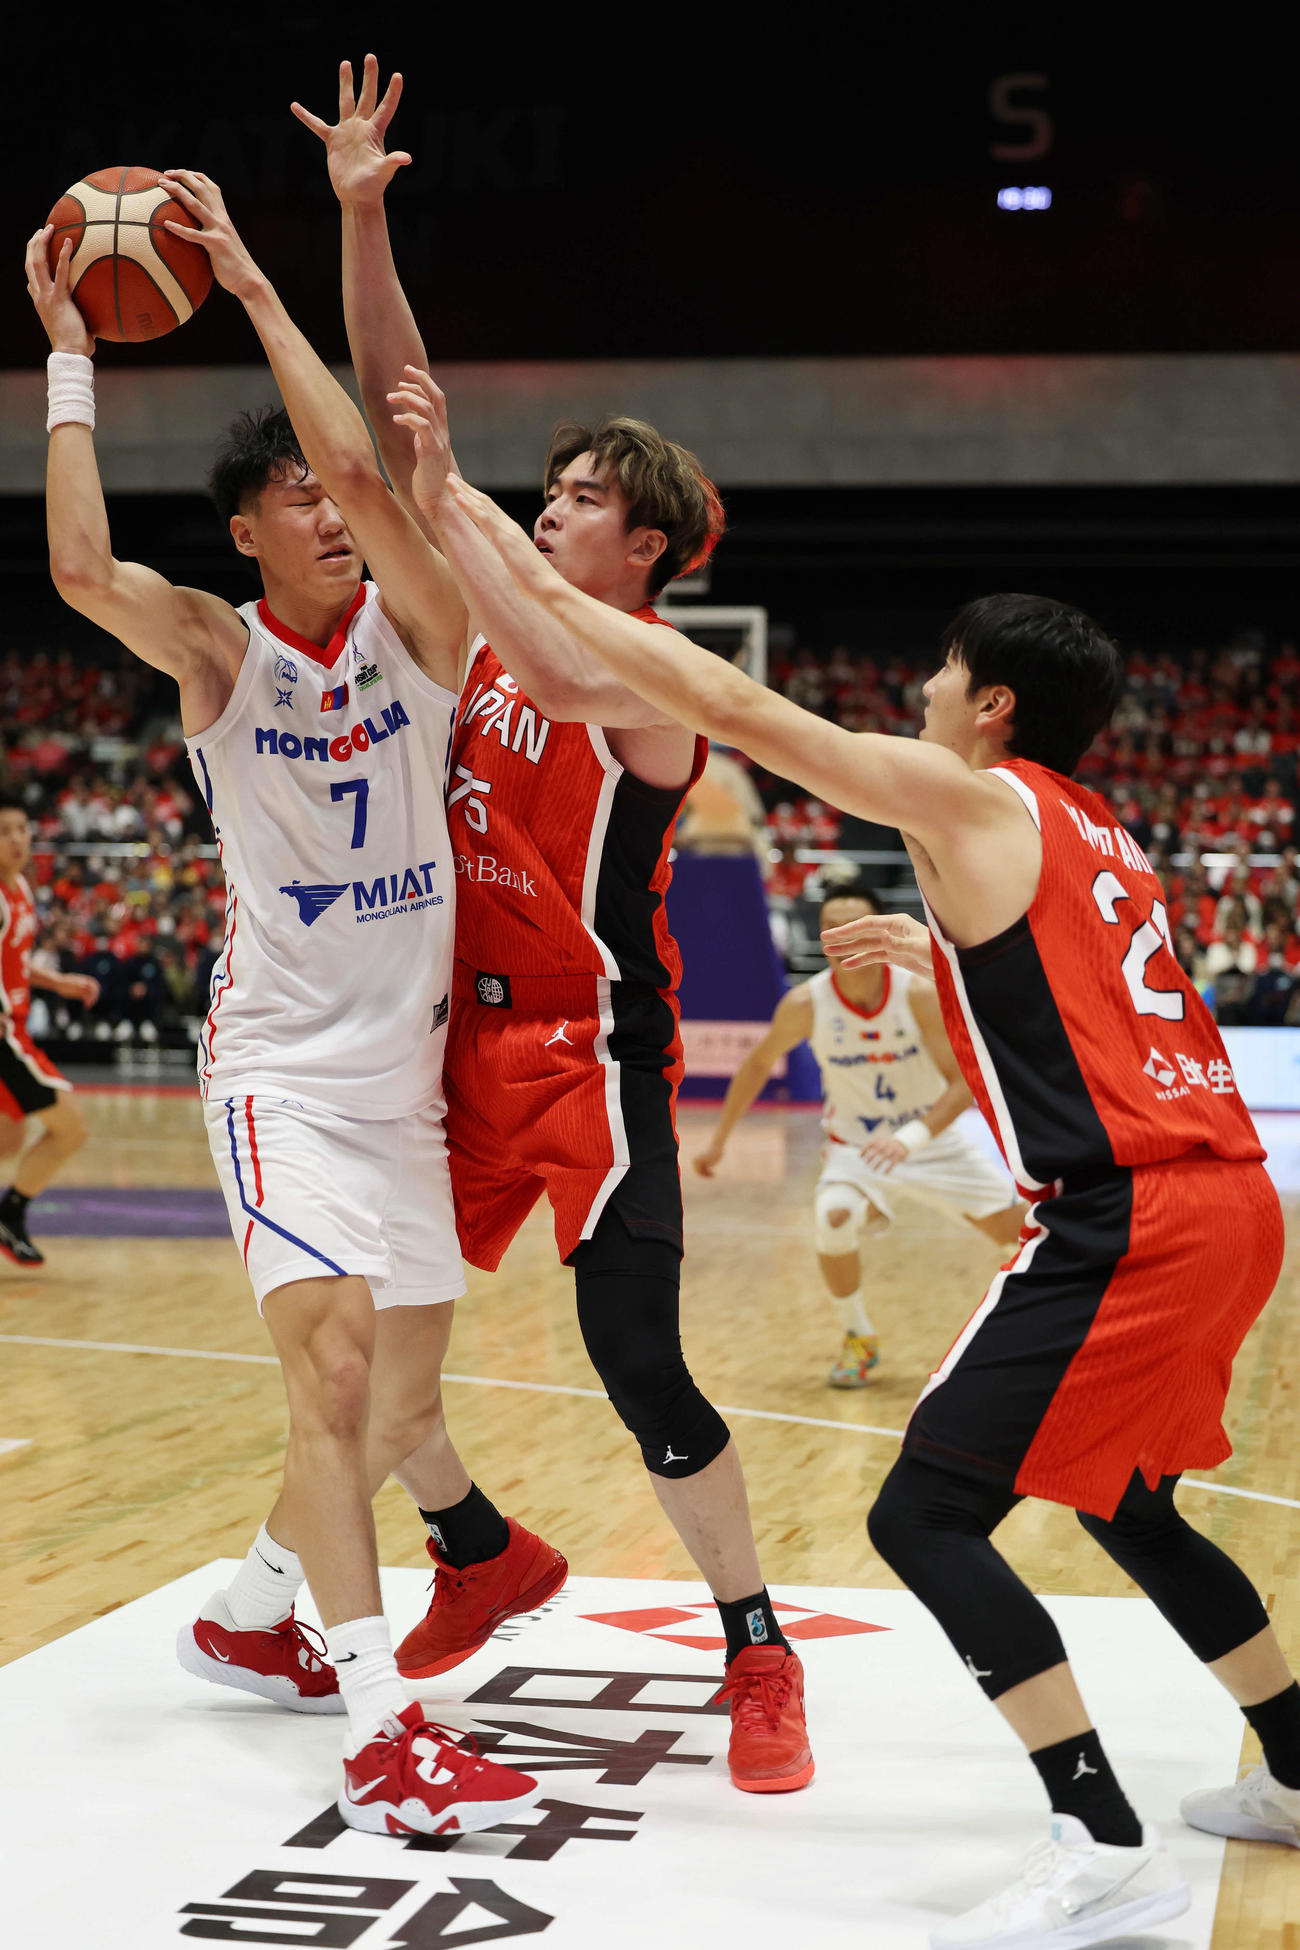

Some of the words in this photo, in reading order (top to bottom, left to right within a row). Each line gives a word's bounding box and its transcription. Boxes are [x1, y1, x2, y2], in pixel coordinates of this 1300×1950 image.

[255, 700, 410, 762] MONGOLIA
[459, 683, 551, 765] PAN
[330, 778, 369, 850] 7
[352, 861, 436, 911] MIAT
[356, 904, 408, 924] MONGOLIAN
[409, 895, 444, 912] AIRINES
[874, 1073, 896, 1102] 4
